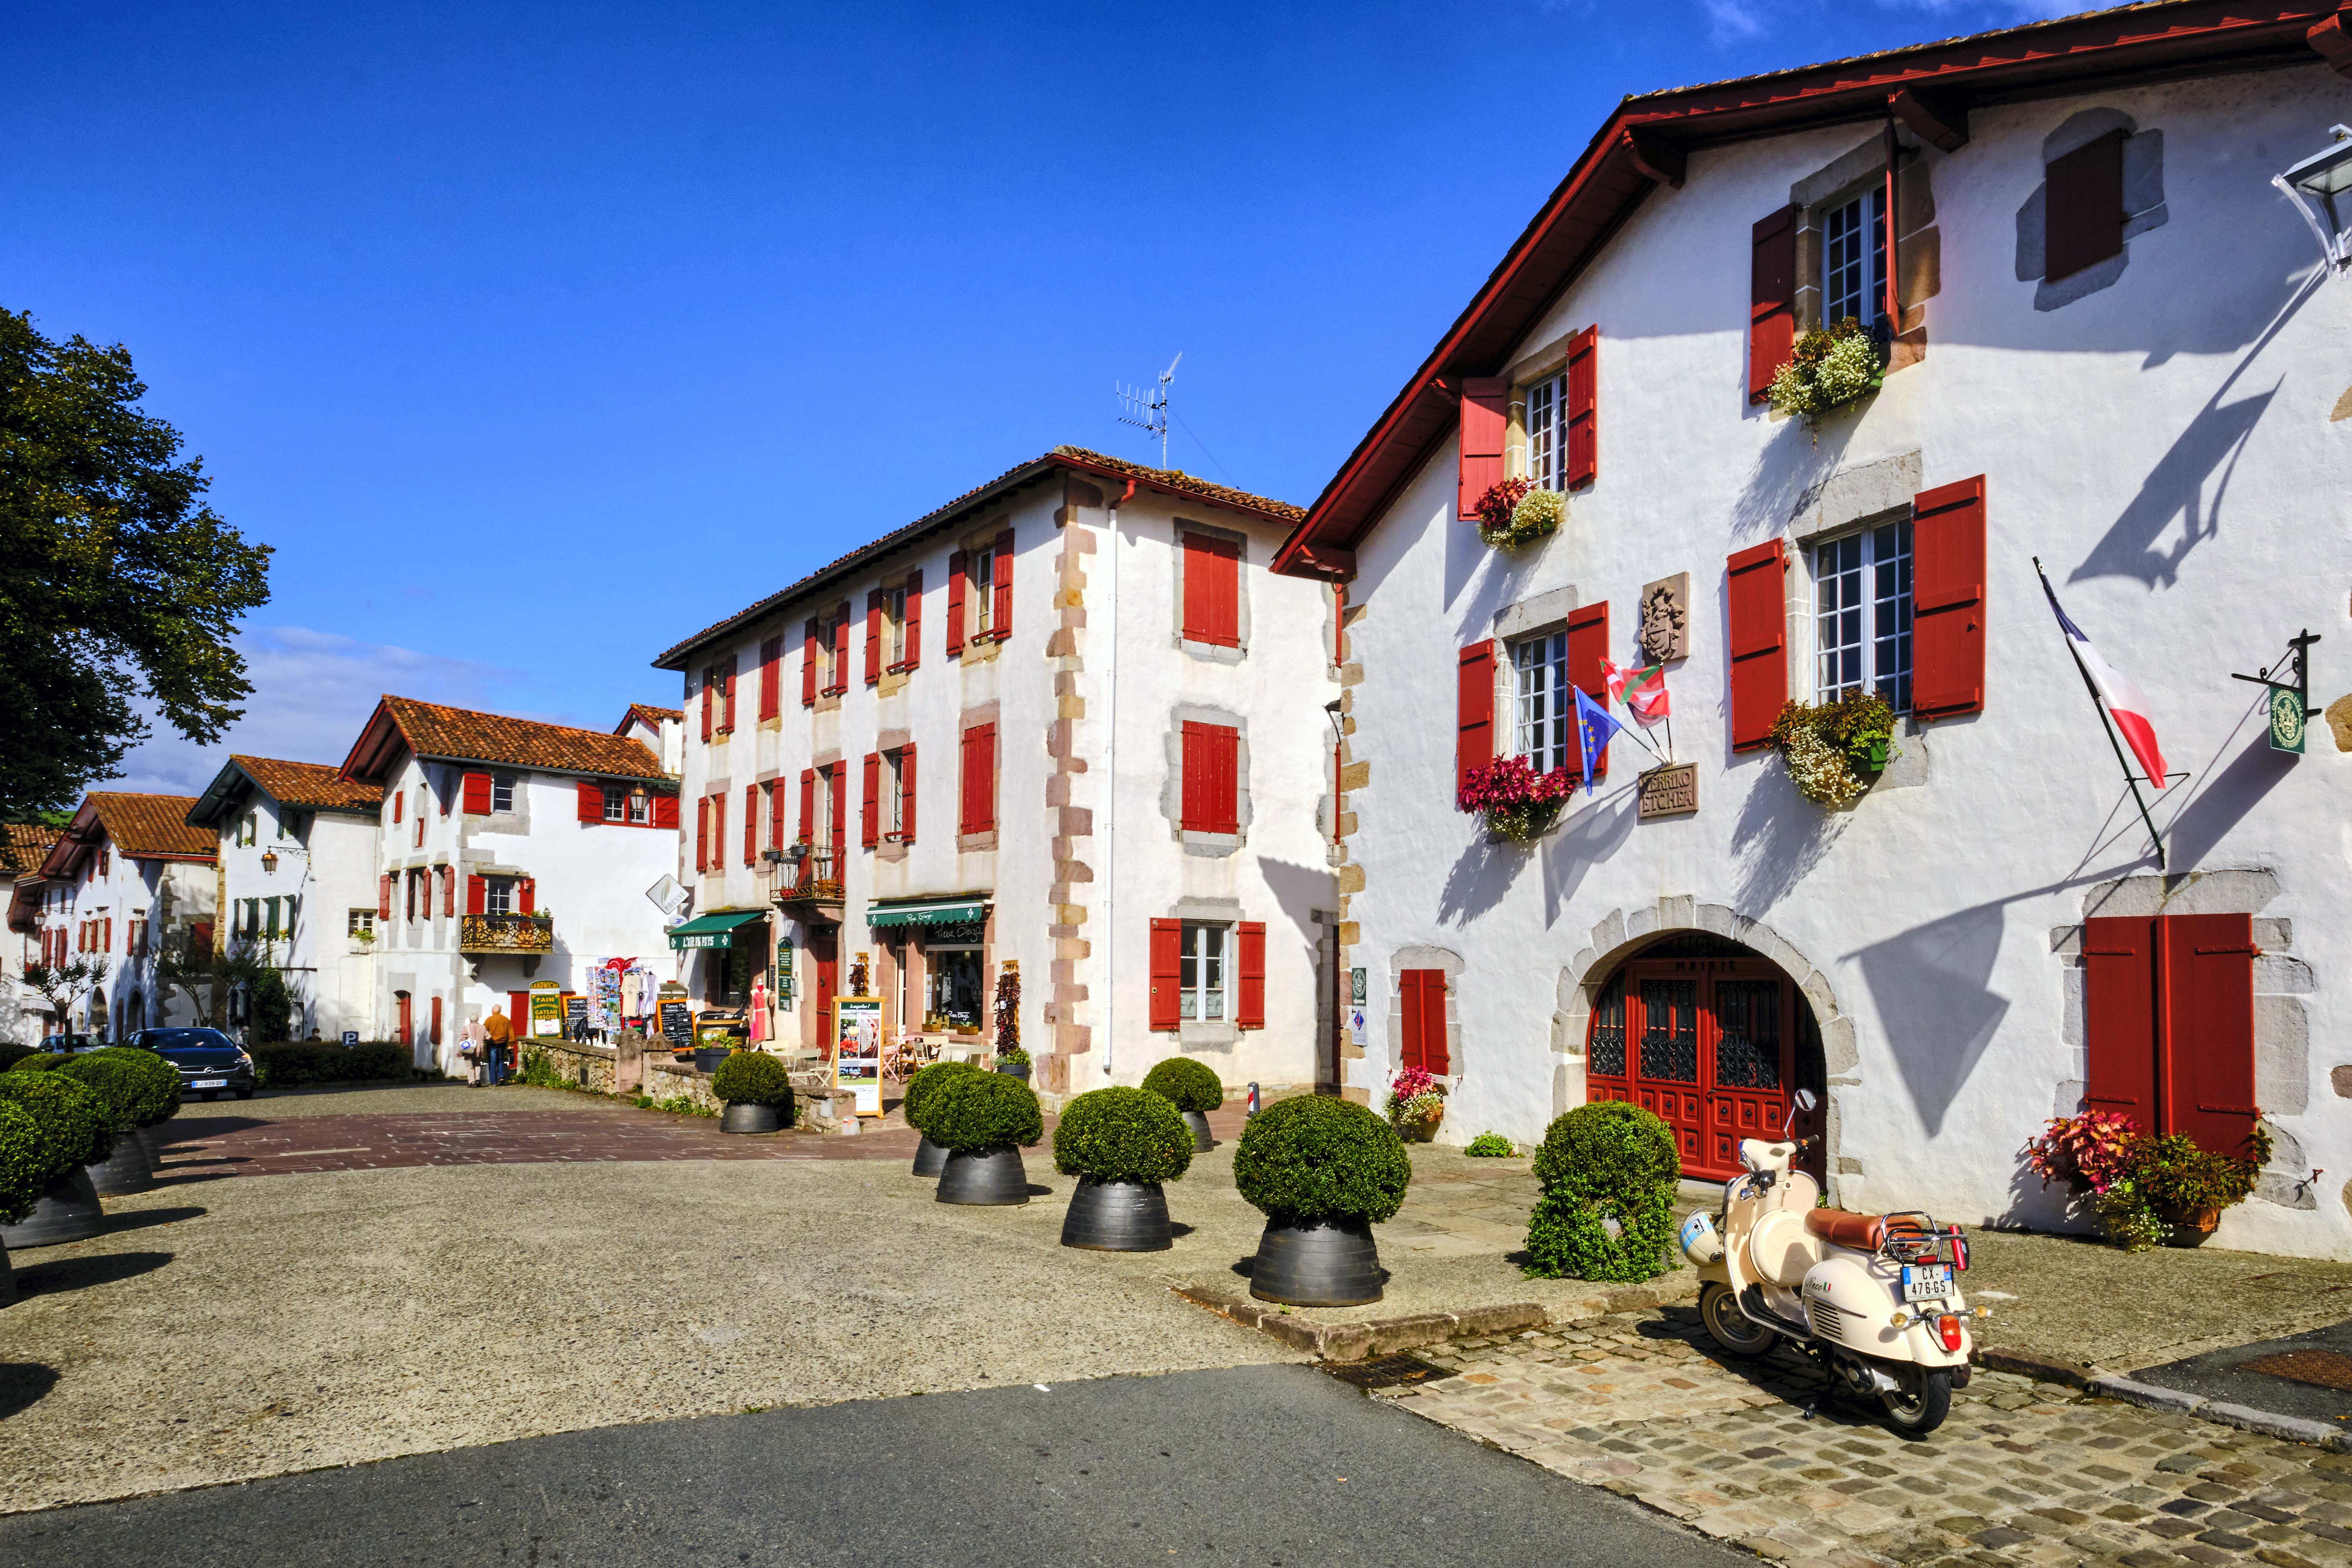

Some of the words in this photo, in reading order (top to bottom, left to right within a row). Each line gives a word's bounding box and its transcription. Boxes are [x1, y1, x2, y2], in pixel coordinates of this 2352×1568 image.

[664, 891, 686, 911] PRESSE
[702, 936, 714, 946] PAYS
[1676, 961, 1737, 972] MAIRIE
[346, 1033, 356, 1044] P
